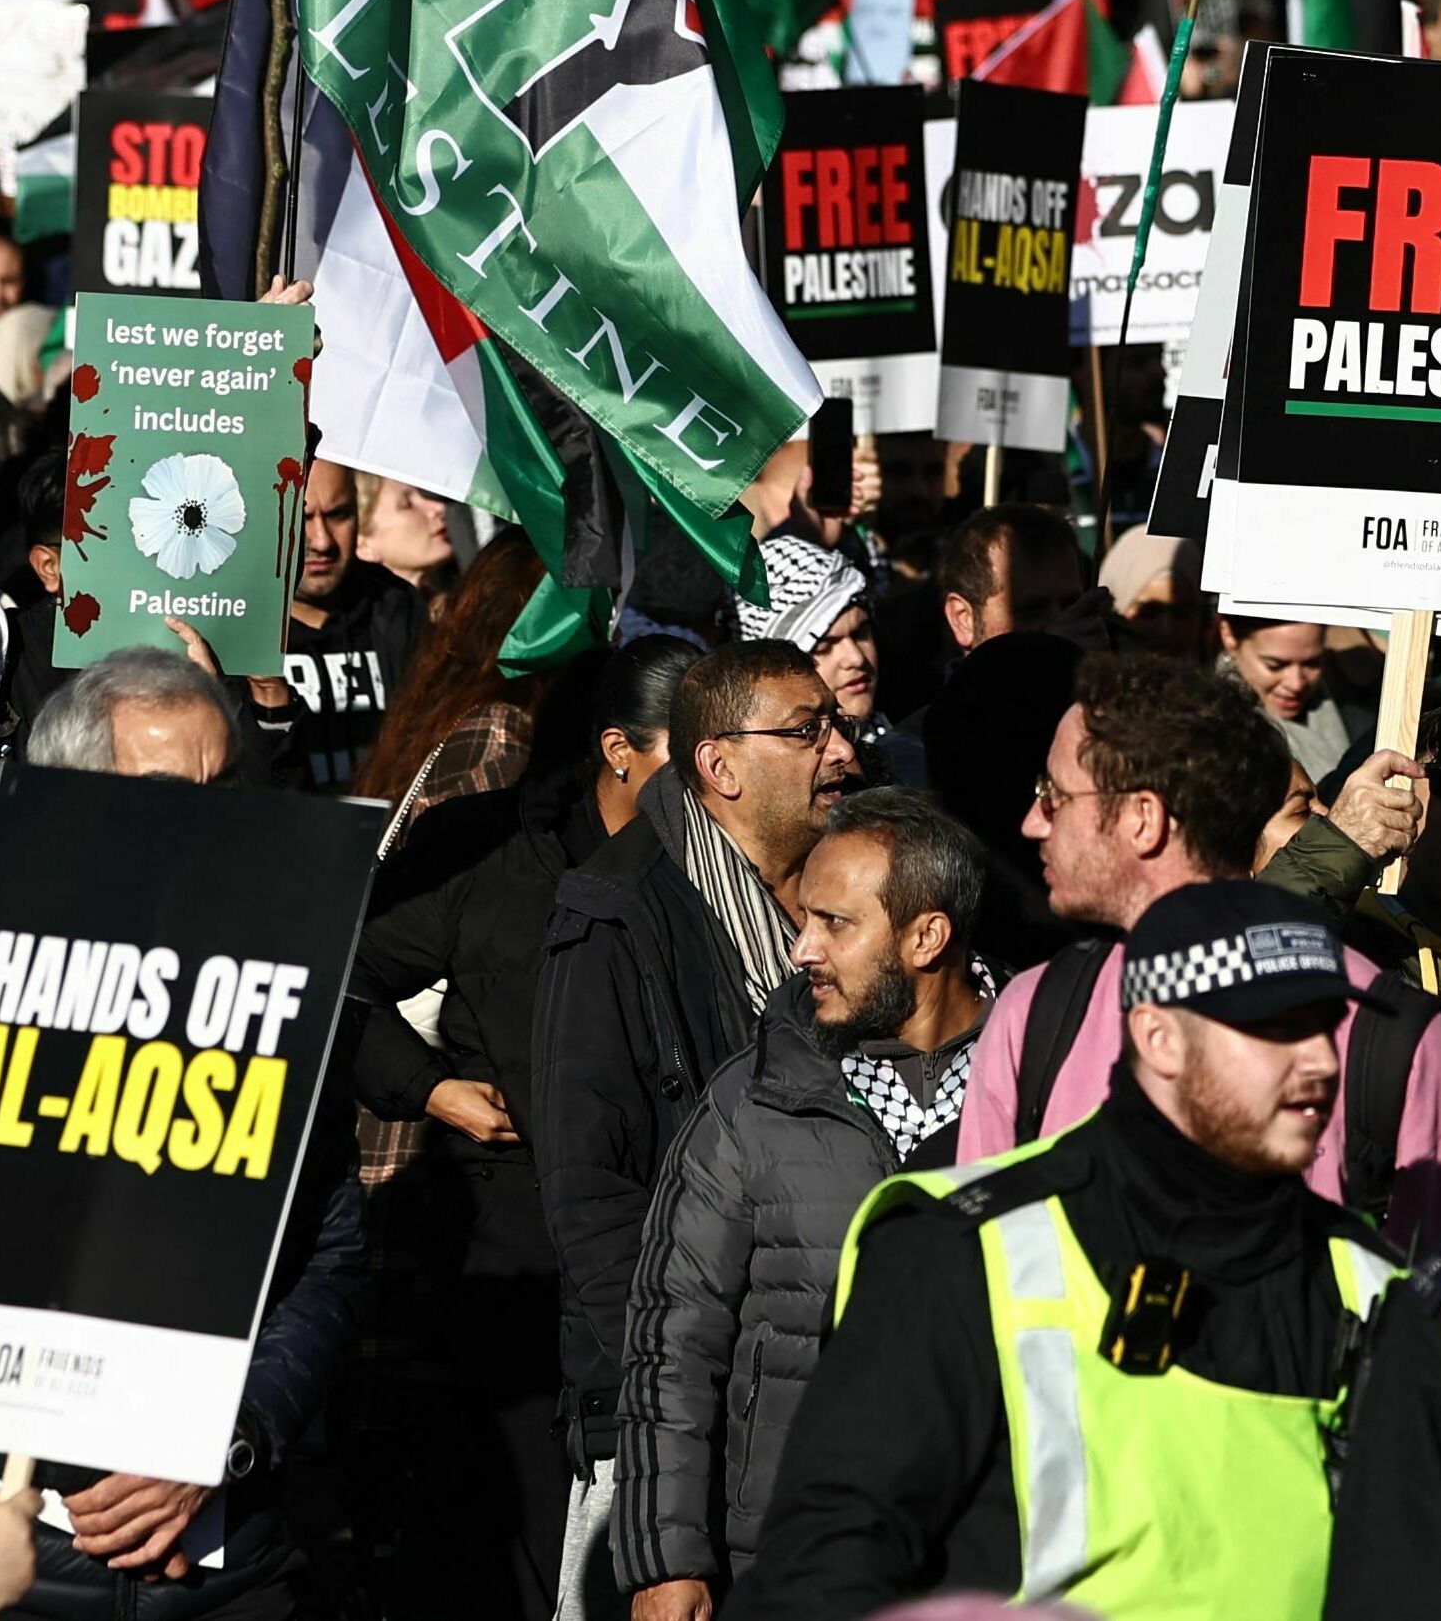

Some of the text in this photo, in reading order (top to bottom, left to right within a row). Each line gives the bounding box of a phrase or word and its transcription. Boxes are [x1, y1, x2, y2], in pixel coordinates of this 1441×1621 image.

[110, 120, 207, 190] STO
[781, 145, 912, 251] FREE
[959, 171, 1069, 230] HANDS OFF
[102, 218, 202, 290] GAZ
[784, 248, 916, 305] PALESTINE
[951, 220, 1068, 296] AL-AQSA
[107, 318, 284, 357] lest we forget
[110, 360, 277, 397] ‘never again’
[134, 405, 245, 435] includes
[1362, 516, 1408, 551] FOA
[1422, 540, 1434, 553] OF
[129, 589, 248, 619] Palestine
[185, 955, 309, 1058] OFF
